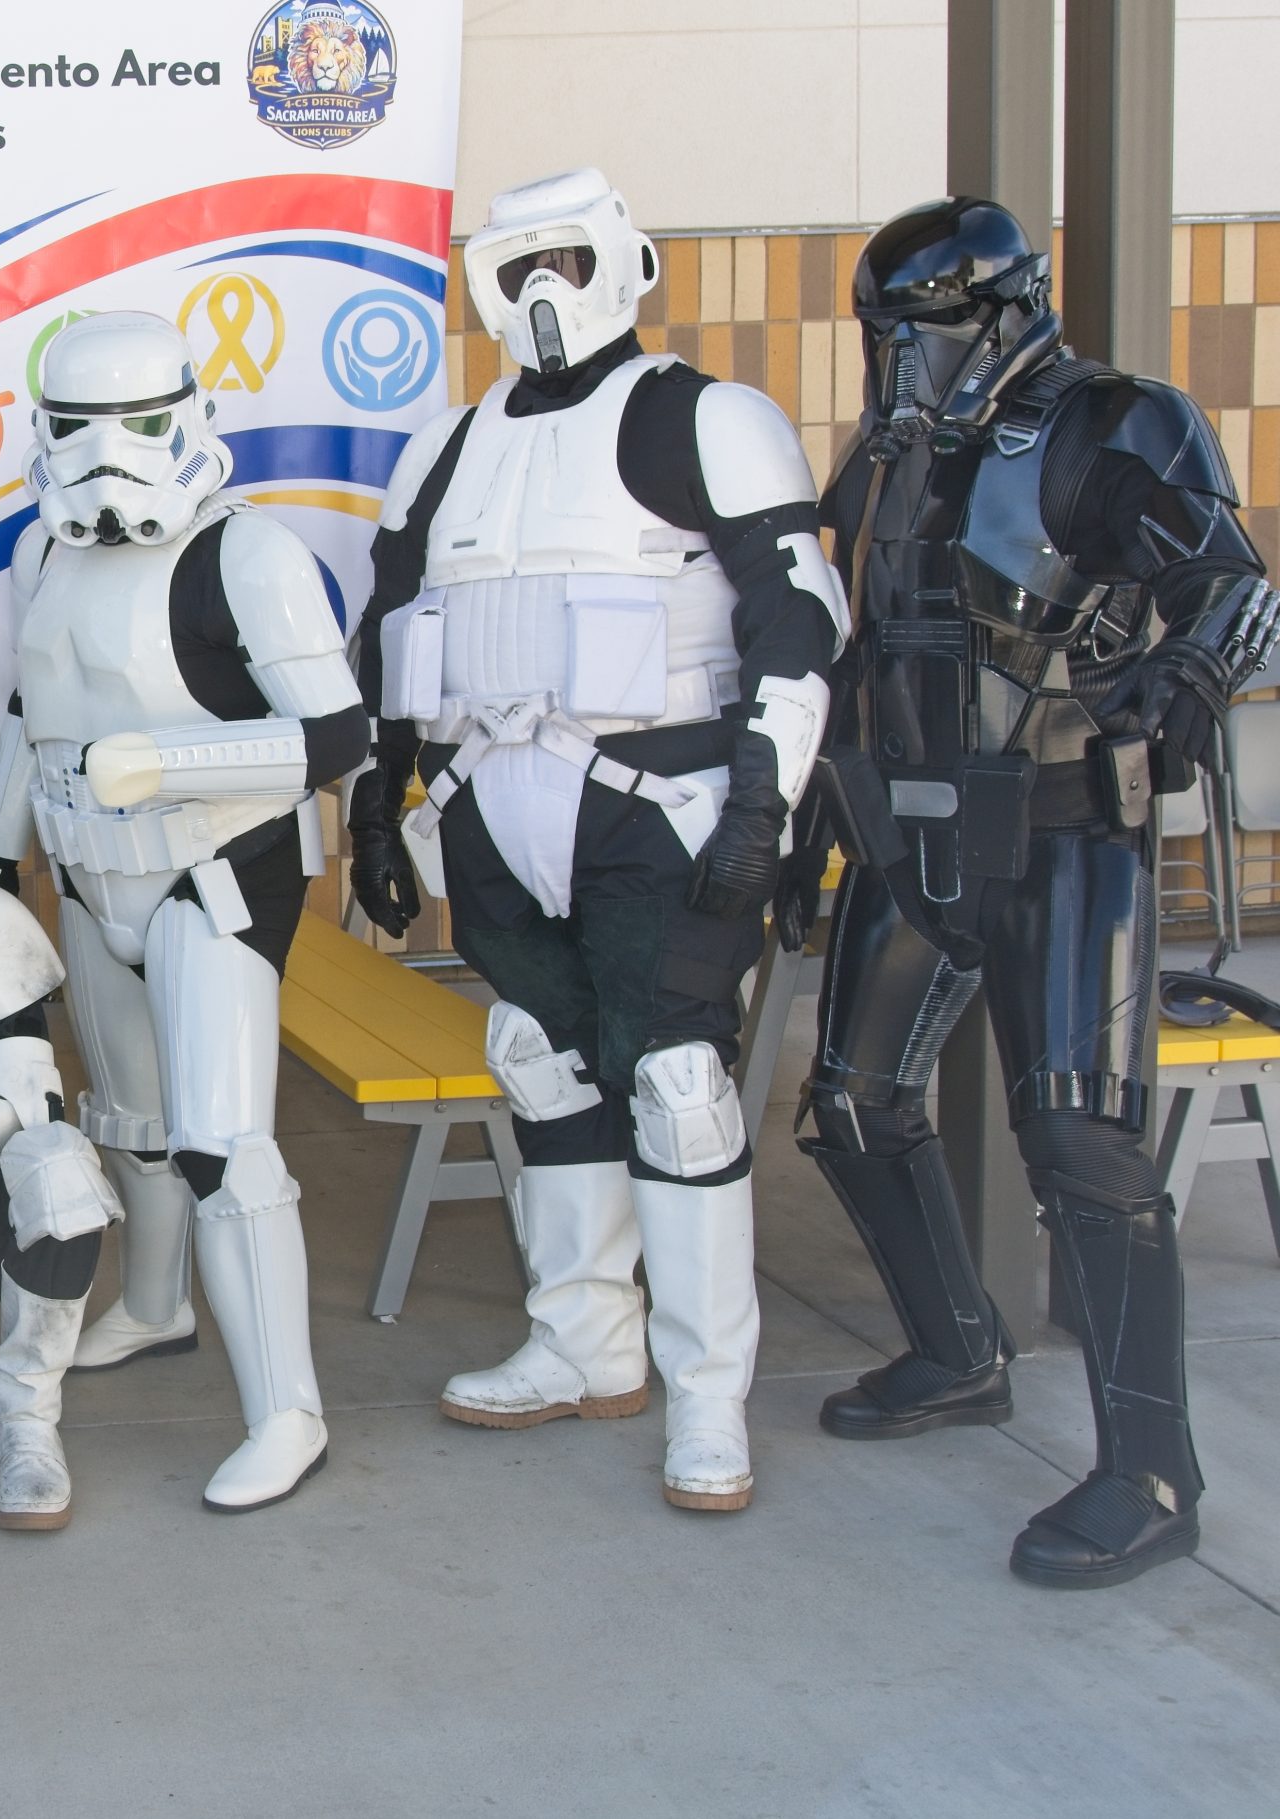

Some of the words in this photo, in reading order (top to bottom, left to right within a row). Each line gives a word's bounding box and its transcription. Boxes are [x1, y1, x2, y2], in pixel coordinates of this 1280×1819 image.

[111, 48, 221, 87] Area
[284, 98, 309, 109] 4-C5
[311, 97, 361, 109] DISTRICT
[266, 105, 344, 122] SACRAMENTO
[346, 107, 377, 122] AREA
[292, 128, 321, 137] LIONS
[323, 128, 352, 137] CLUBS
